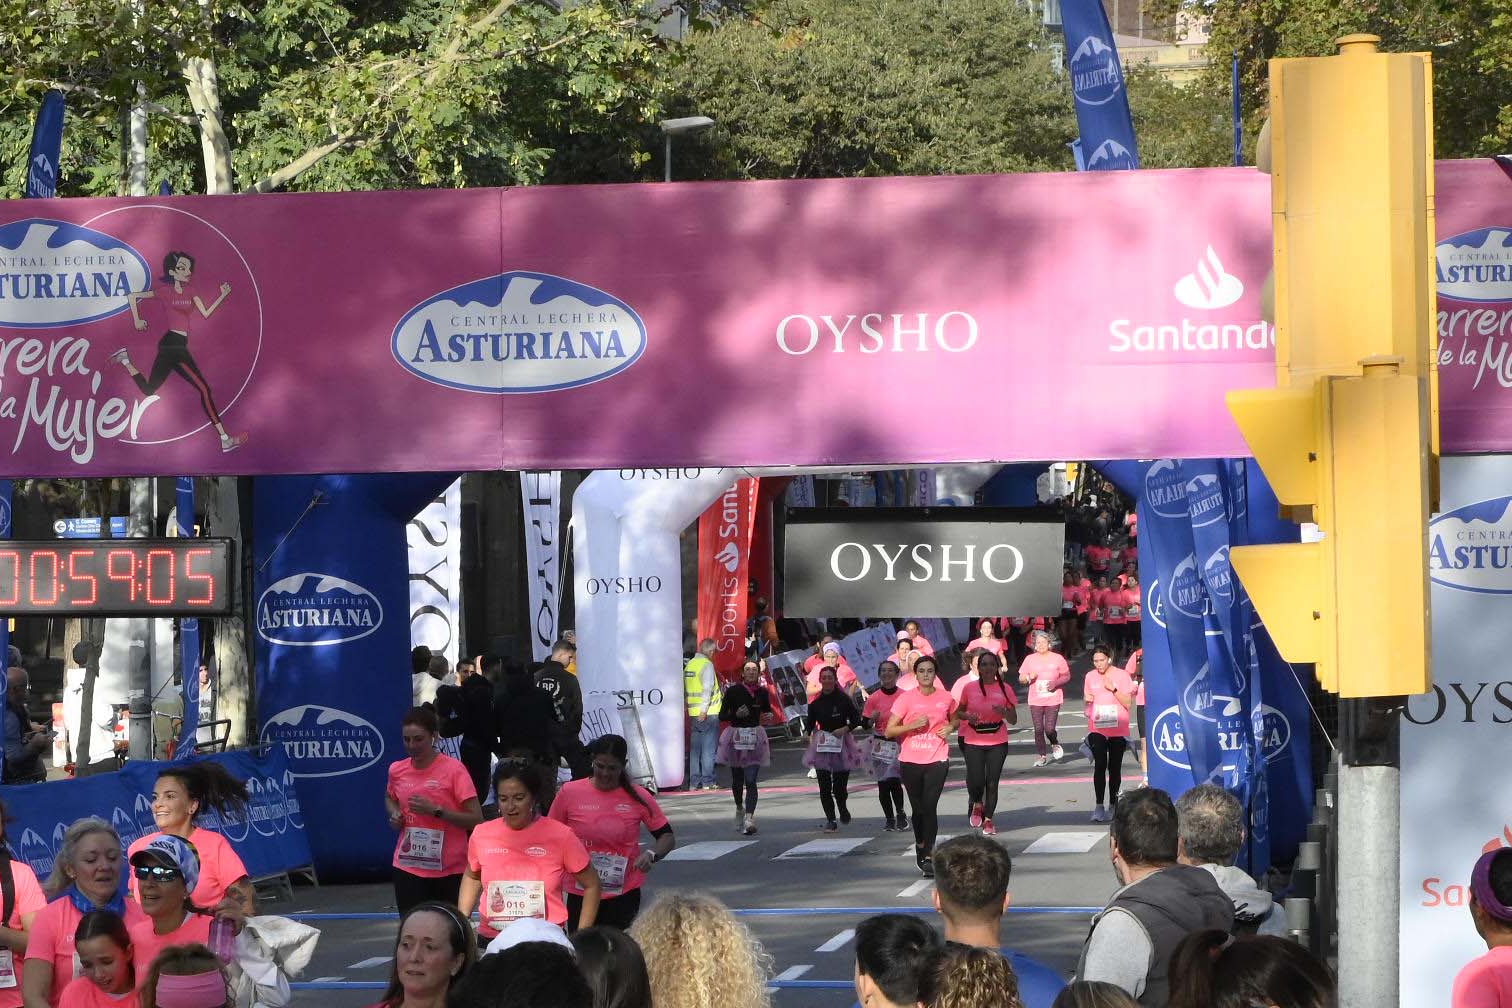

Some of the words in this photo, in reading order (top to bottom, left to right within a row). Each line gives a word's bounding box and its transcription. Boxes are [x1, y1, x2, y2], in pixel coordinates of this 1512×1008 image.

[54, 254, 127, 267] LECHERA
[450, 314, 529, 327] CENTRAL
[537, 312, 618, 326] LECHERA
[1436, 308, 1512, 337] arrer
[411, 319, 627, 364] ASTURIANA
[776, 312, 979, 356] OYSHO
[11, 371, 161, 464] Mujer
[619, 468, 701, 481] OYSHO
[830, 543, 1024, 584] OYSHO
[586, 575, 662, 595] OYSHO
[273, 598, 315, 607] CENTRAL
[320, 597, 369, 605] LECHERA
[716, 576, 738, 652] Sports
[261, 602, 374, 629] ASTURIANA
[616, 688, 664, 708] SHO
[581, 706, 611, 742] SHO
[265, 734, 374, 759] TURIANA
[598, 870, 609, 878] 16
[506, 901, 525, 909] 016
